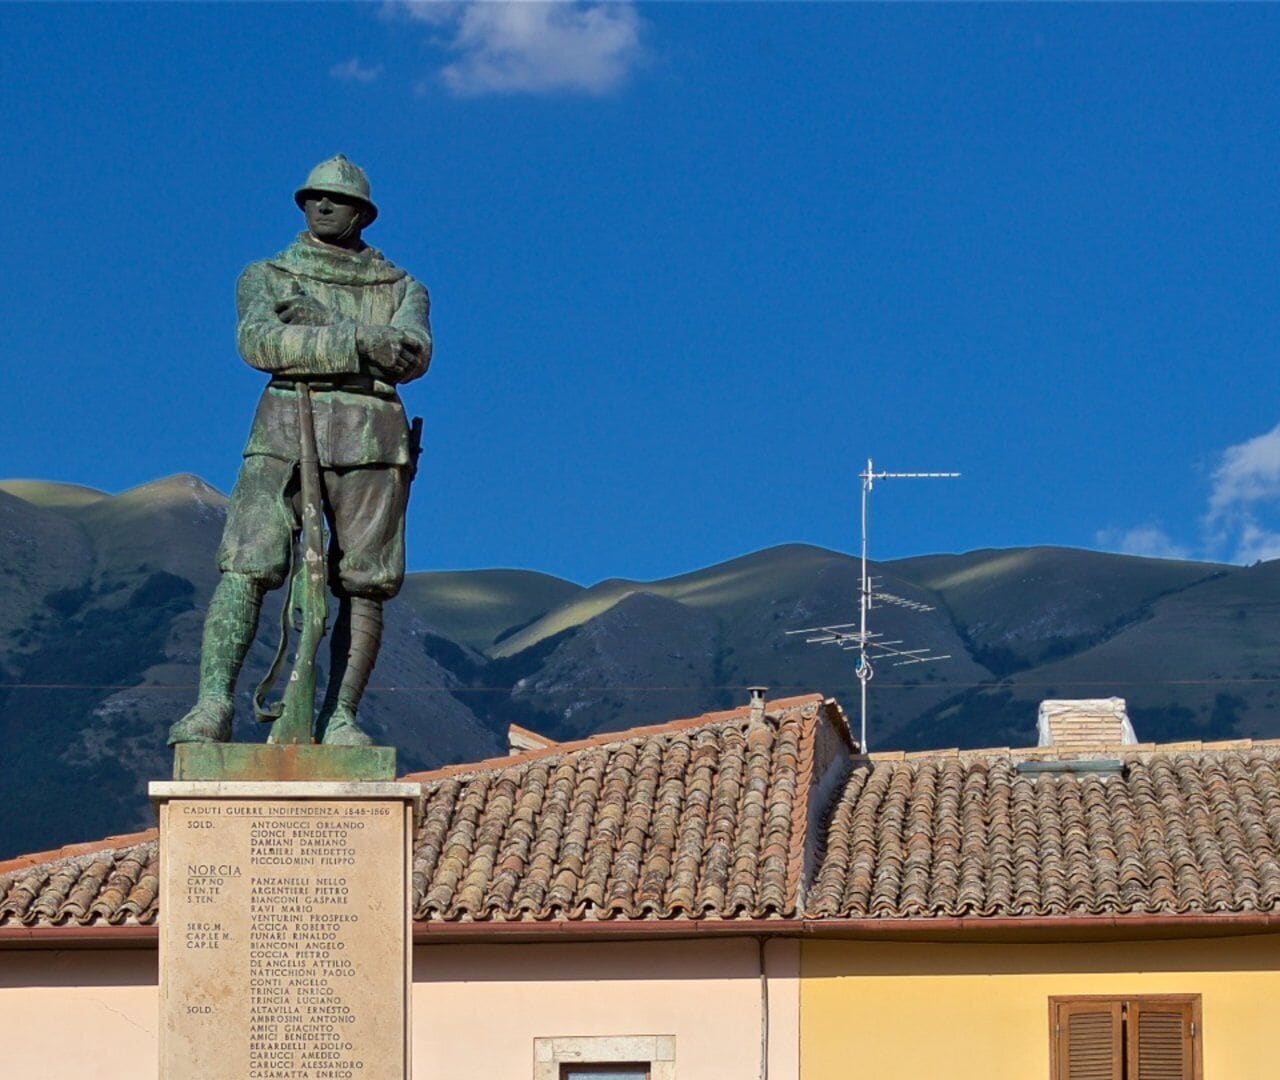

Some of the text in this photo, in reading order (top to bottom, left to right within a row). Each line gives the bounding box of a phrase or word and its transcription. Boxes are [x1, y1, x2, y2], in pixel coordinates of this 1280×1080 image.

[183, 807, 222, 815] CADUTI
[226, 807, 263, 815] GUERRE
[250, 821, 365, 830] ANTONUCCI ORLANDO
[250, 829, 348, 838] CIONCI BENEDETTO
[250, 838, 347, 847] DAMIANI DAMIANO
[300, 847, 356, 856] BENEDETTO
[250, 856, 356, 865] PICCOLOMINI FILIPPO
[187, 864, 242, 876] NORCIA
[316, 878, 347, 887] NELLO
[250, 896, 349, 905] BIANCONI GASPARE
[250, 905, 313, 914] RAVI MARIO
[250, 914, 359, 923] VENTURINI PROSPERO
[250, 923, 341, 932] ACCICA ROBERTO
[249, 932, 337, 941] FUNARI RINALDO
[249, 941, 345, 950] BIANCONI ANGELO
[249, 950, 289, 959] COCCIA
[266, 959, 306, 968] ANGELIS
[312, 959, 352, 968] ATTILIO
[249, 968, 356, 977] NATICCHIONI PAOLO
[249, 978, 328, 987] CONTI ANGELO
[249, 987, 334, 996] TRINCIA ENRICO
[249, 996, 342, 1005] TRINCIA LUCIANO
[249, 1006, 351, 1015] ALTAVILLA ERNESTO
[249, 1015, 356, 1024] AMBROSINI ANTONIO
[249, 1024, 334, 1033] AMICI GIACINTO
[249, 1032, 341, 1041] AMICI BENEDETTO
[313, 1042, 353, 1051] ADOLFO
[249, 1051, 341, 1060] CARUCCI AMEDEO
[249, 1060, 364, 1069] CARUCCI ALESSANDRO
[315, 1070, 353, 1079] ENRICO
